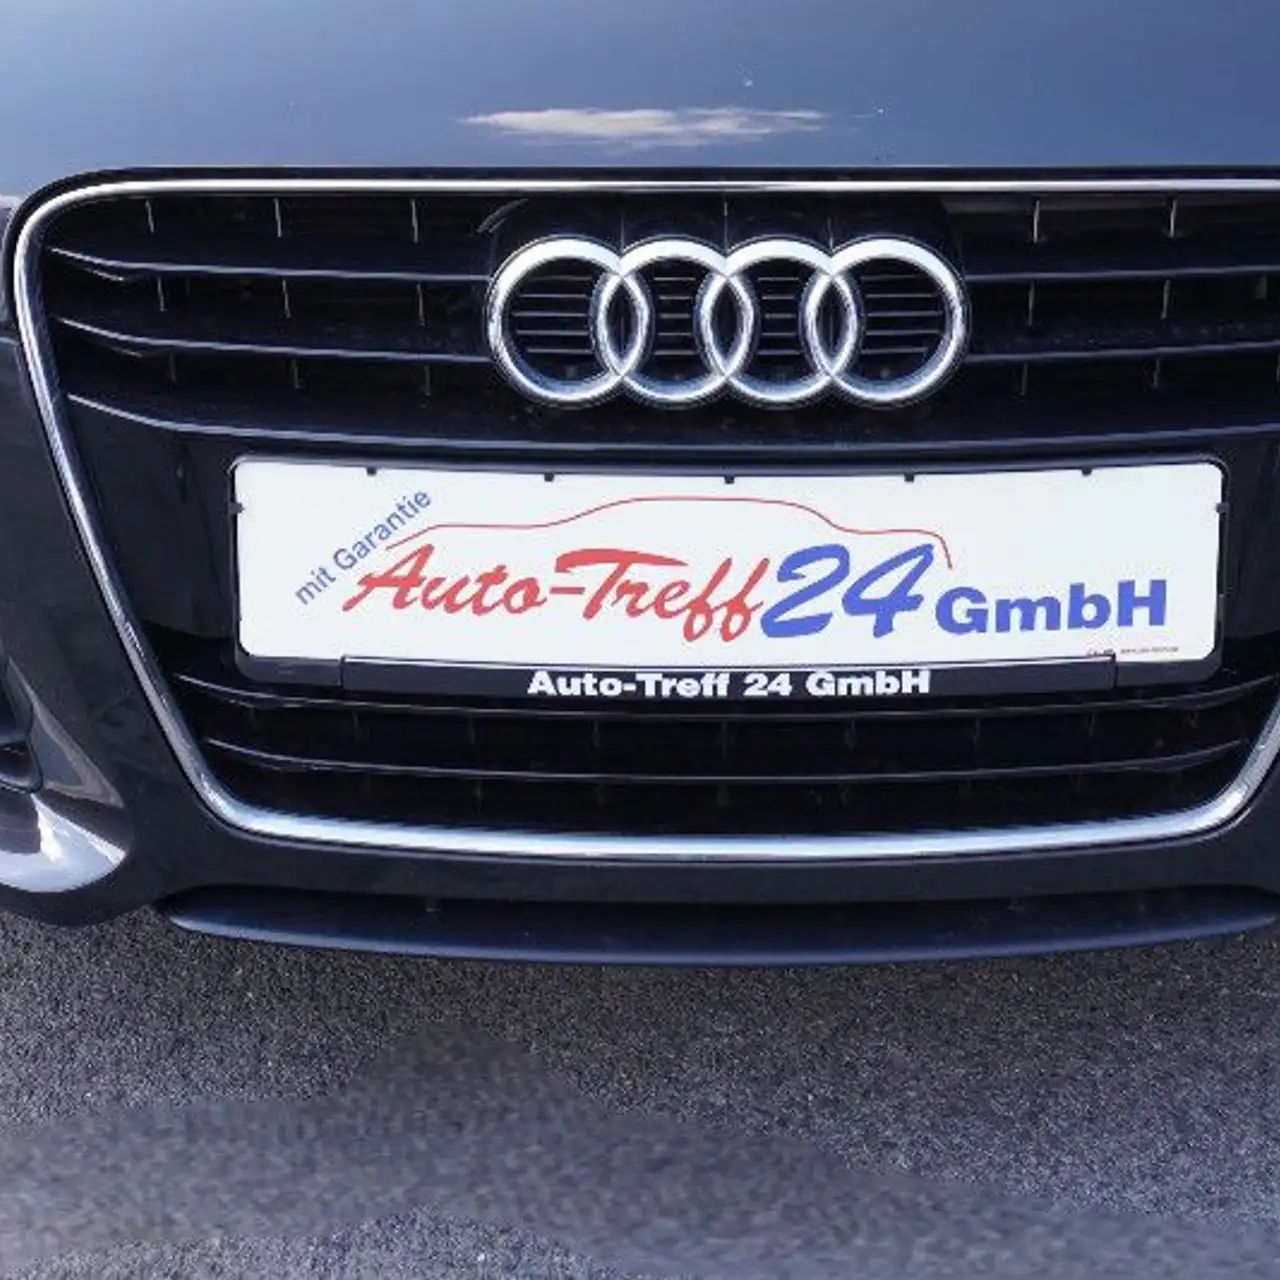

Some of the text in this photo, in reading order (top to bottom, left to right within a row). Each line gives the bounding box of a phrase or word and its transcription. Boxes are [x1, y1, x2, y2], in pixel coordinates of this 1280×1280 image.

[295, 490, 432, 605] mit Garantie
[935, 579, 1168, 636] GmbH
[527, 670, 931, 699] Auto-Treff 24 GmbH
